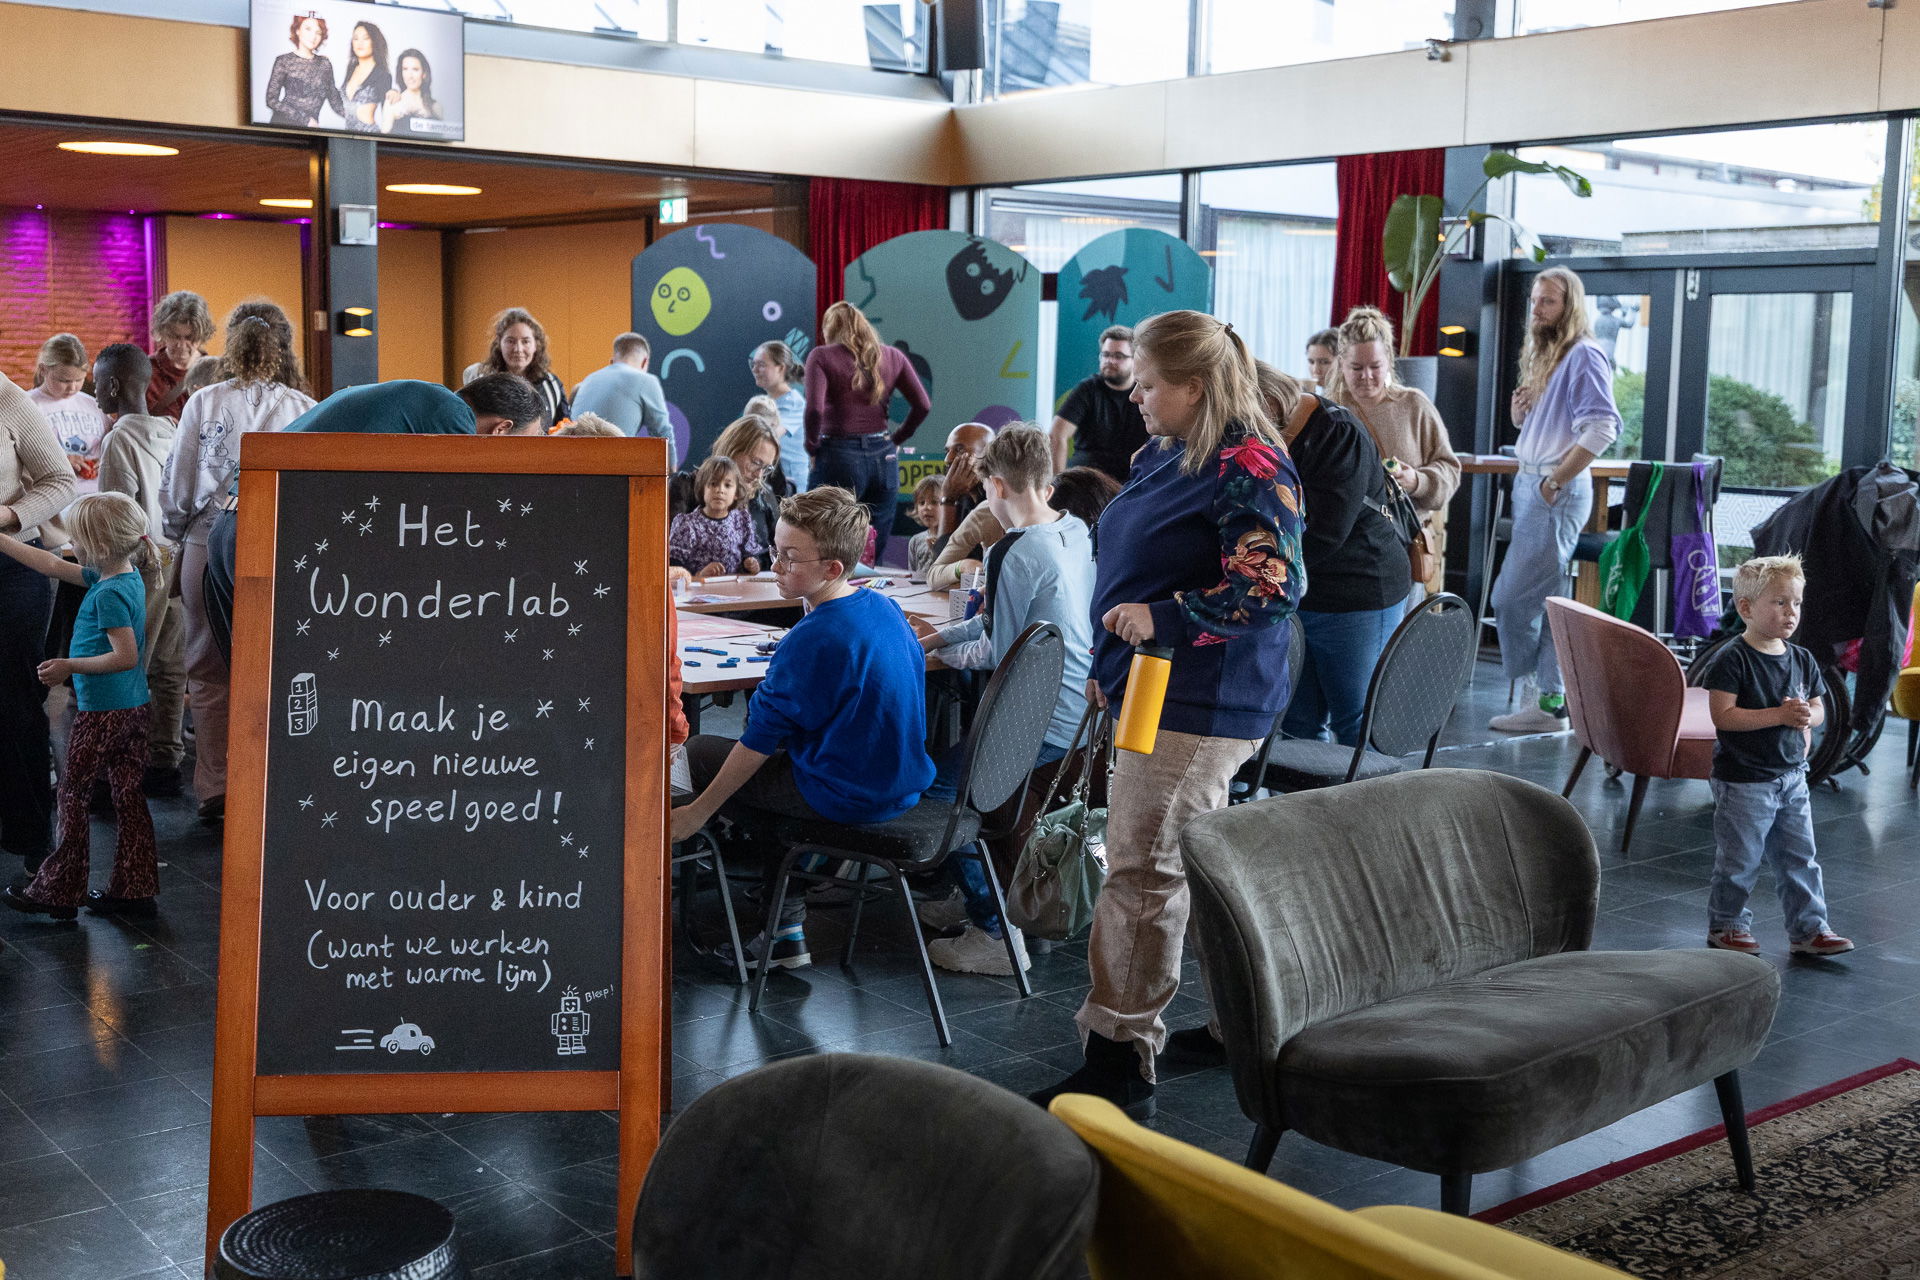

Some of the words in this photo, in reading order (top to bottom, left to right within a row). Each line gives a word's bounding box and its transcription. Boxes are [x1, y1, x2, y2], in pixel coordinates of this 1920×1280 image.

[399, 503, 483, 547] Het
[309, 567, 569, 618] Wonderlab
[296, 683, 302, 692] 1
[294, 699, 302, 709] 2
[351, 696, 455, 732] Maak
[472, 704, 509, 741] je
[295, 718, 303, 730] 3
[333, 751, 415, 789] eigen
[434, 753, 539, 776] nieuwe
[305, 879, 375, 911] Voor
[390, 880, 476, 911] ouder
[491, 889, 506, 911] &
[519, 880, 582, 909] kind
[406, 937, 442, 955] we
[451, 930, 548, 956] werken
[346, 966, 393, 989] met
[407, 967, 485, 984] warme
